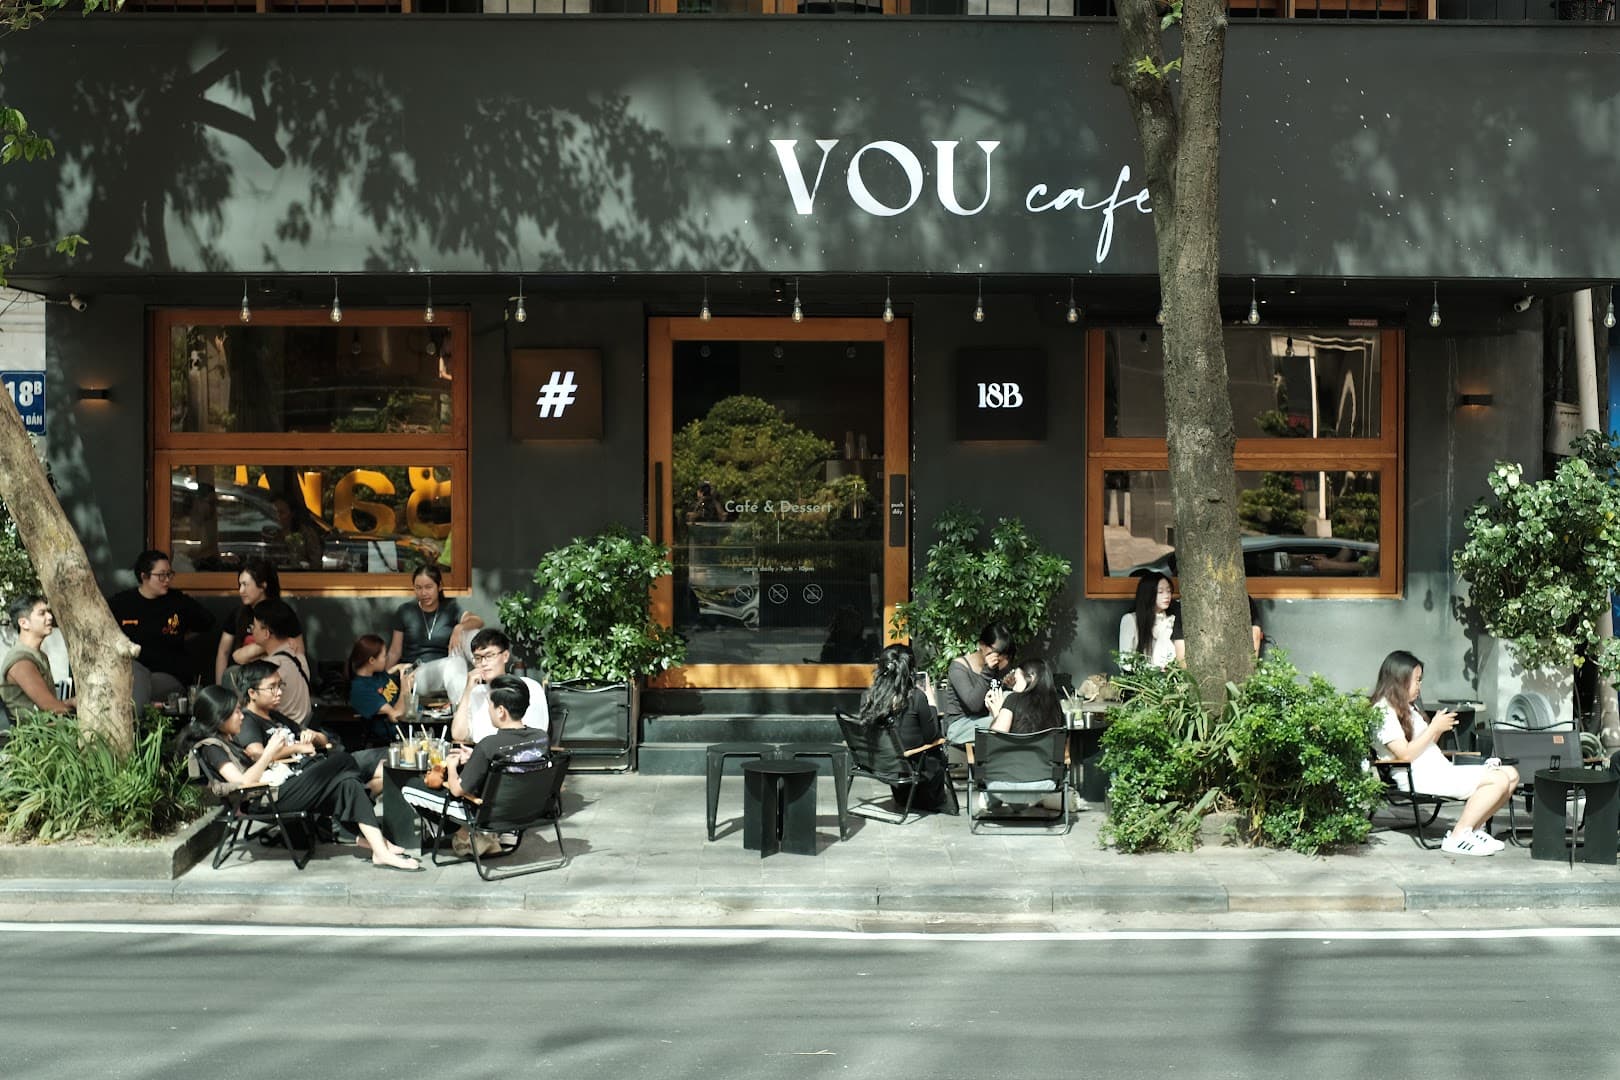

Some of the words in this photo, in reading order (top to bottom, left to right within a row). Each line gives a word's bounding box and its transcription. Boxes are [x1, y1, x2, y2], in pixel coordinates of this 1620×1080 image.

[770, 139, 1000, 217] VOU
[536, 371, 578, 418] #
[977, 382, 1024, 408] 18B
[725, 499, 759, 513] Café
[763, 500, 775, 513] &
[780, 500, 833, 513] Dessert
